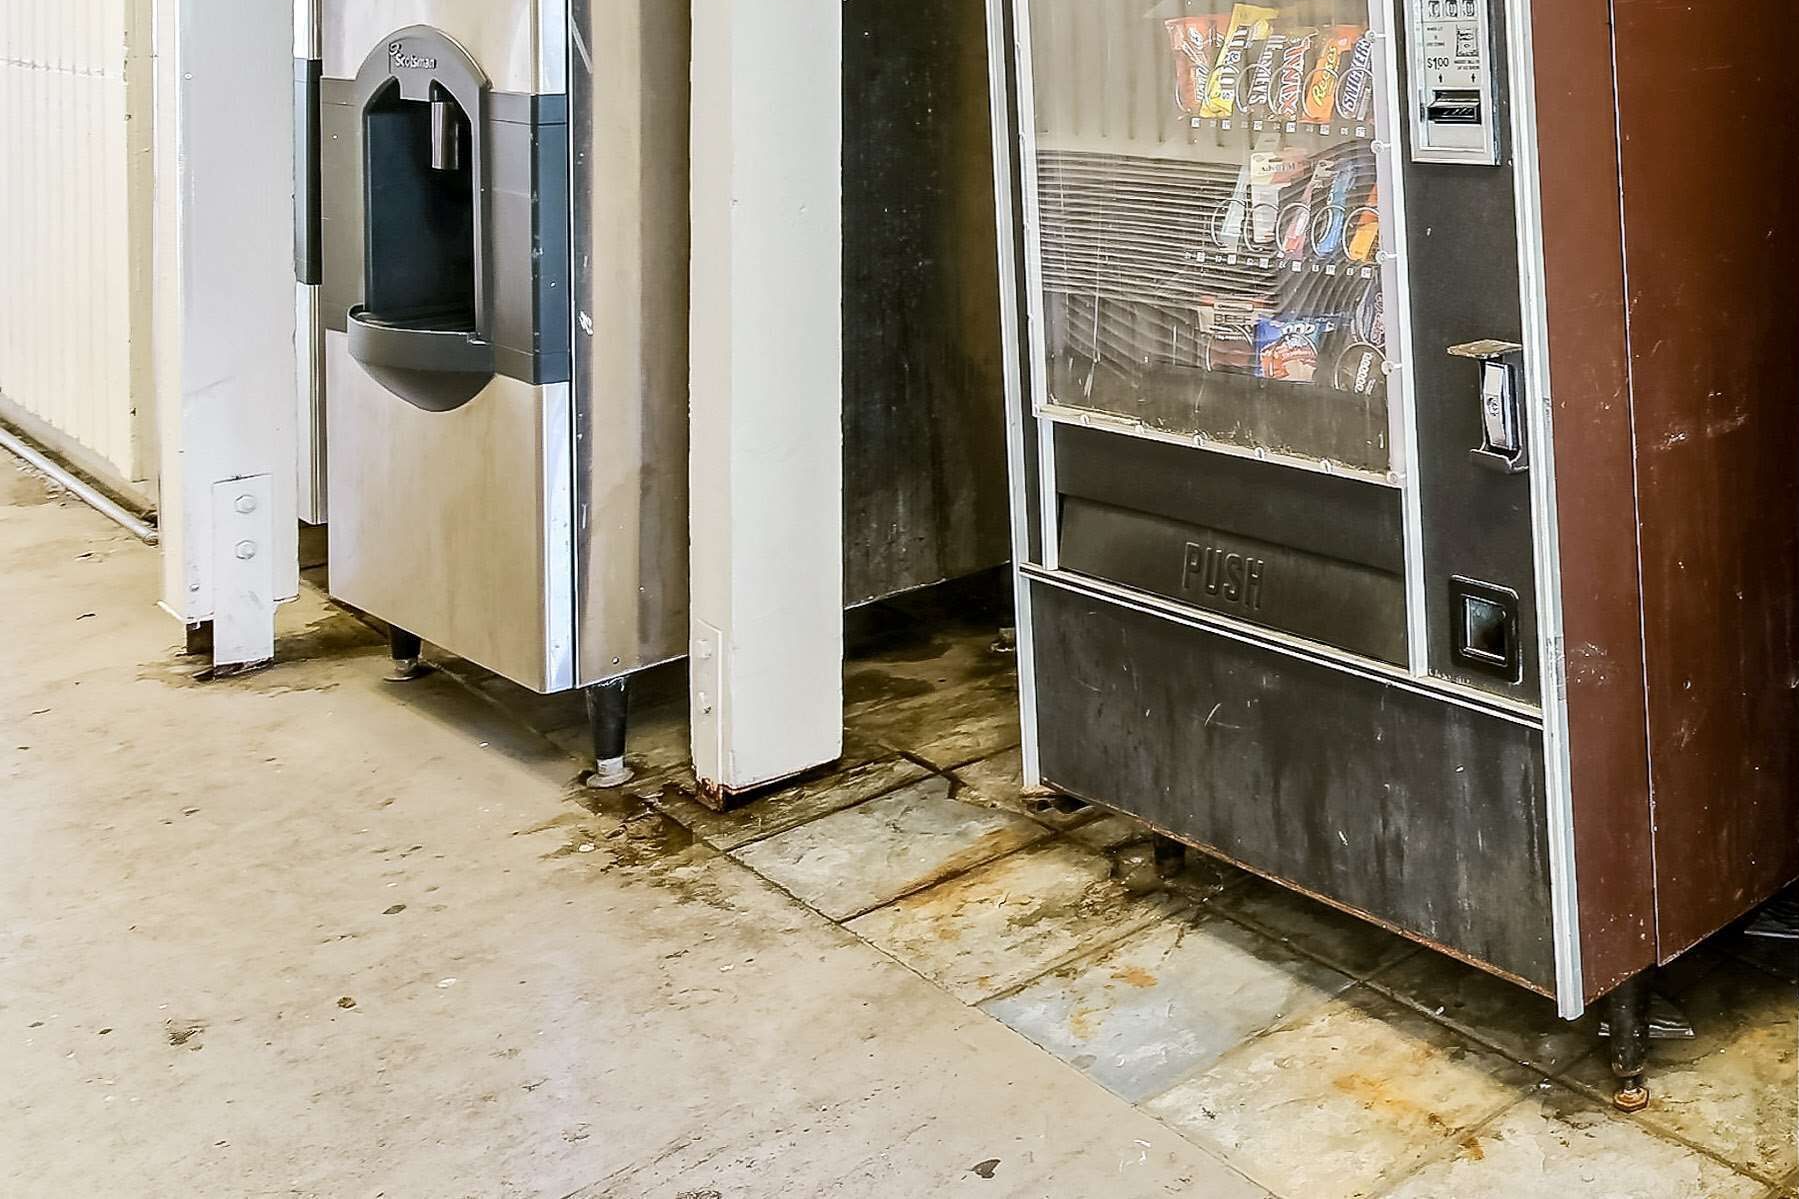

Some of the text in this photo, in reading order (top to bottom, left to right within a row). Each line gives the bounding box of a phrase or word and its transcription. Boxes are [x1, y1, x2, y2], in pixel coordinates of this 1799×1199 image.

[395, 53, 435, 68] Scotsman
[1427, 57, 1449, 70] $1.00
[1182, 541, 1264, 610] PUSH
